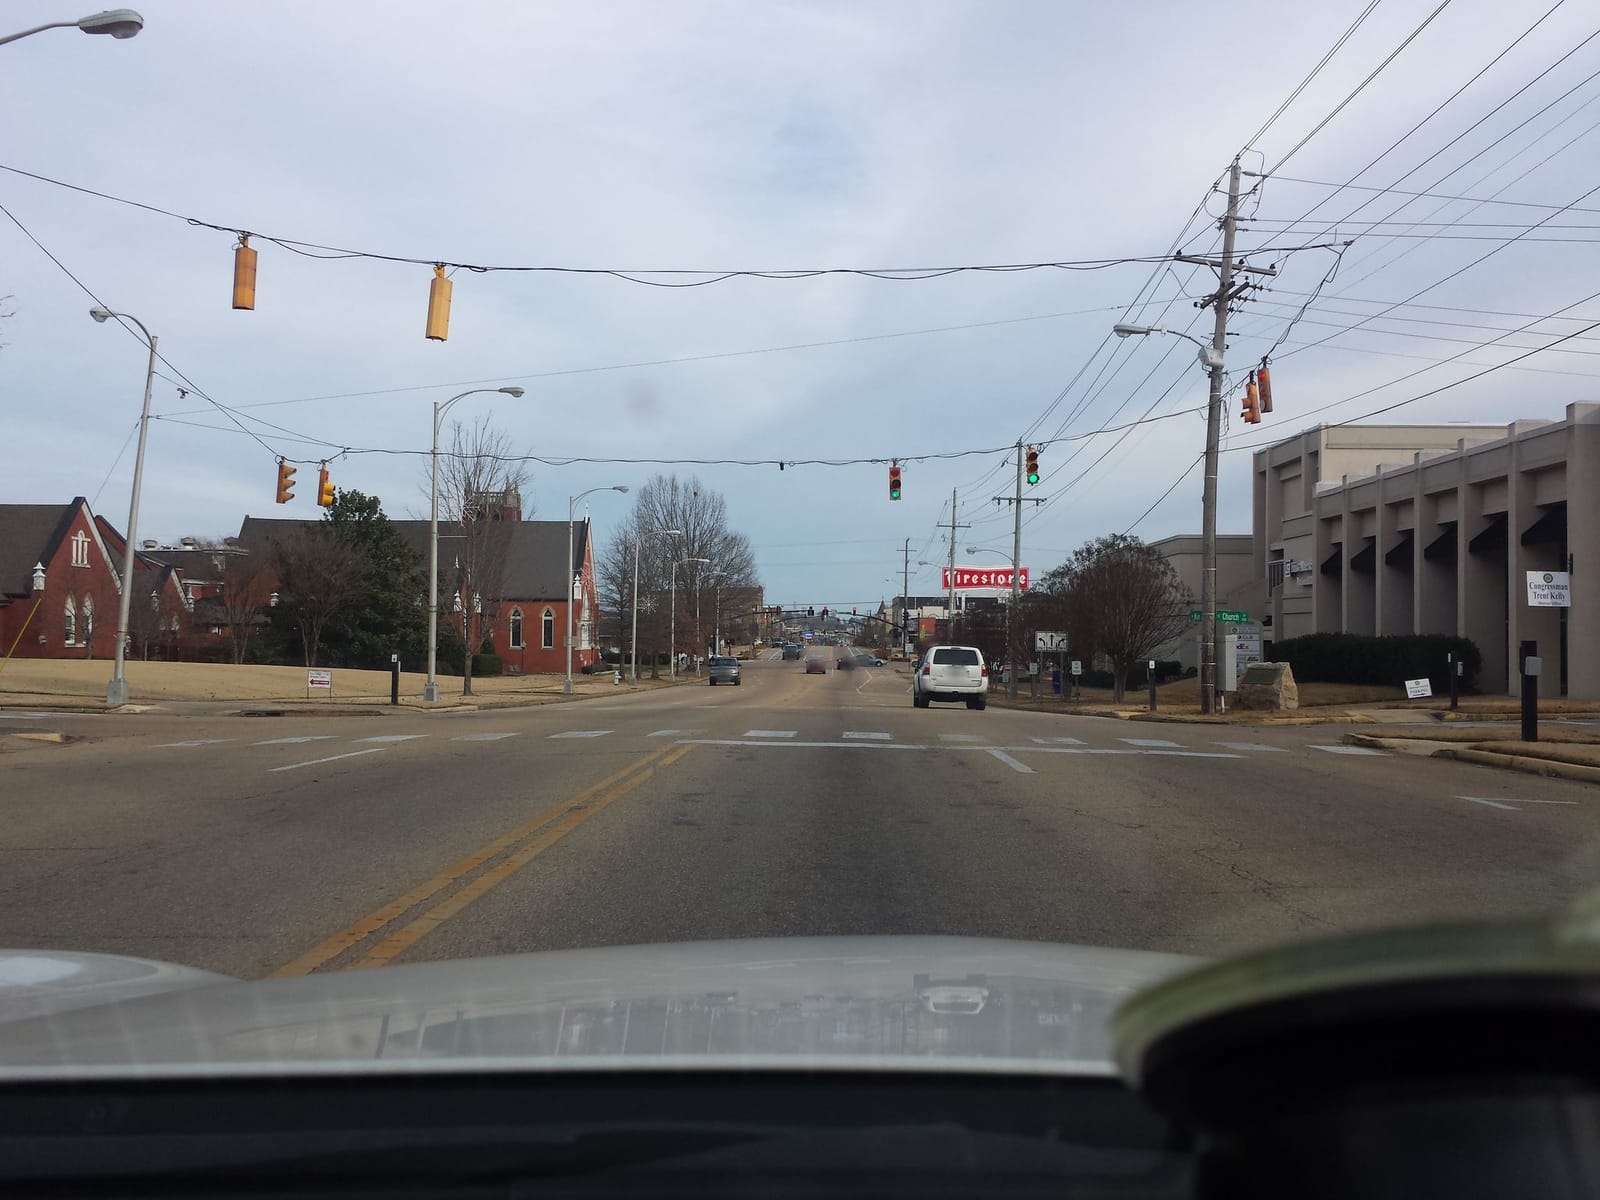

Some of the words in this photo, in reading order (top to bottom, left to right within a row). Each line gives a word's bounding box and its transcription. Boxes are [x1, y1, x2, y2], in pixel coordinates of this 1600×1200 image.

[1529, 582, 1568, 591] Congressman
[1550, 592, 1565, 602] Kelly
[1222, 613, 1240, 621] Church
